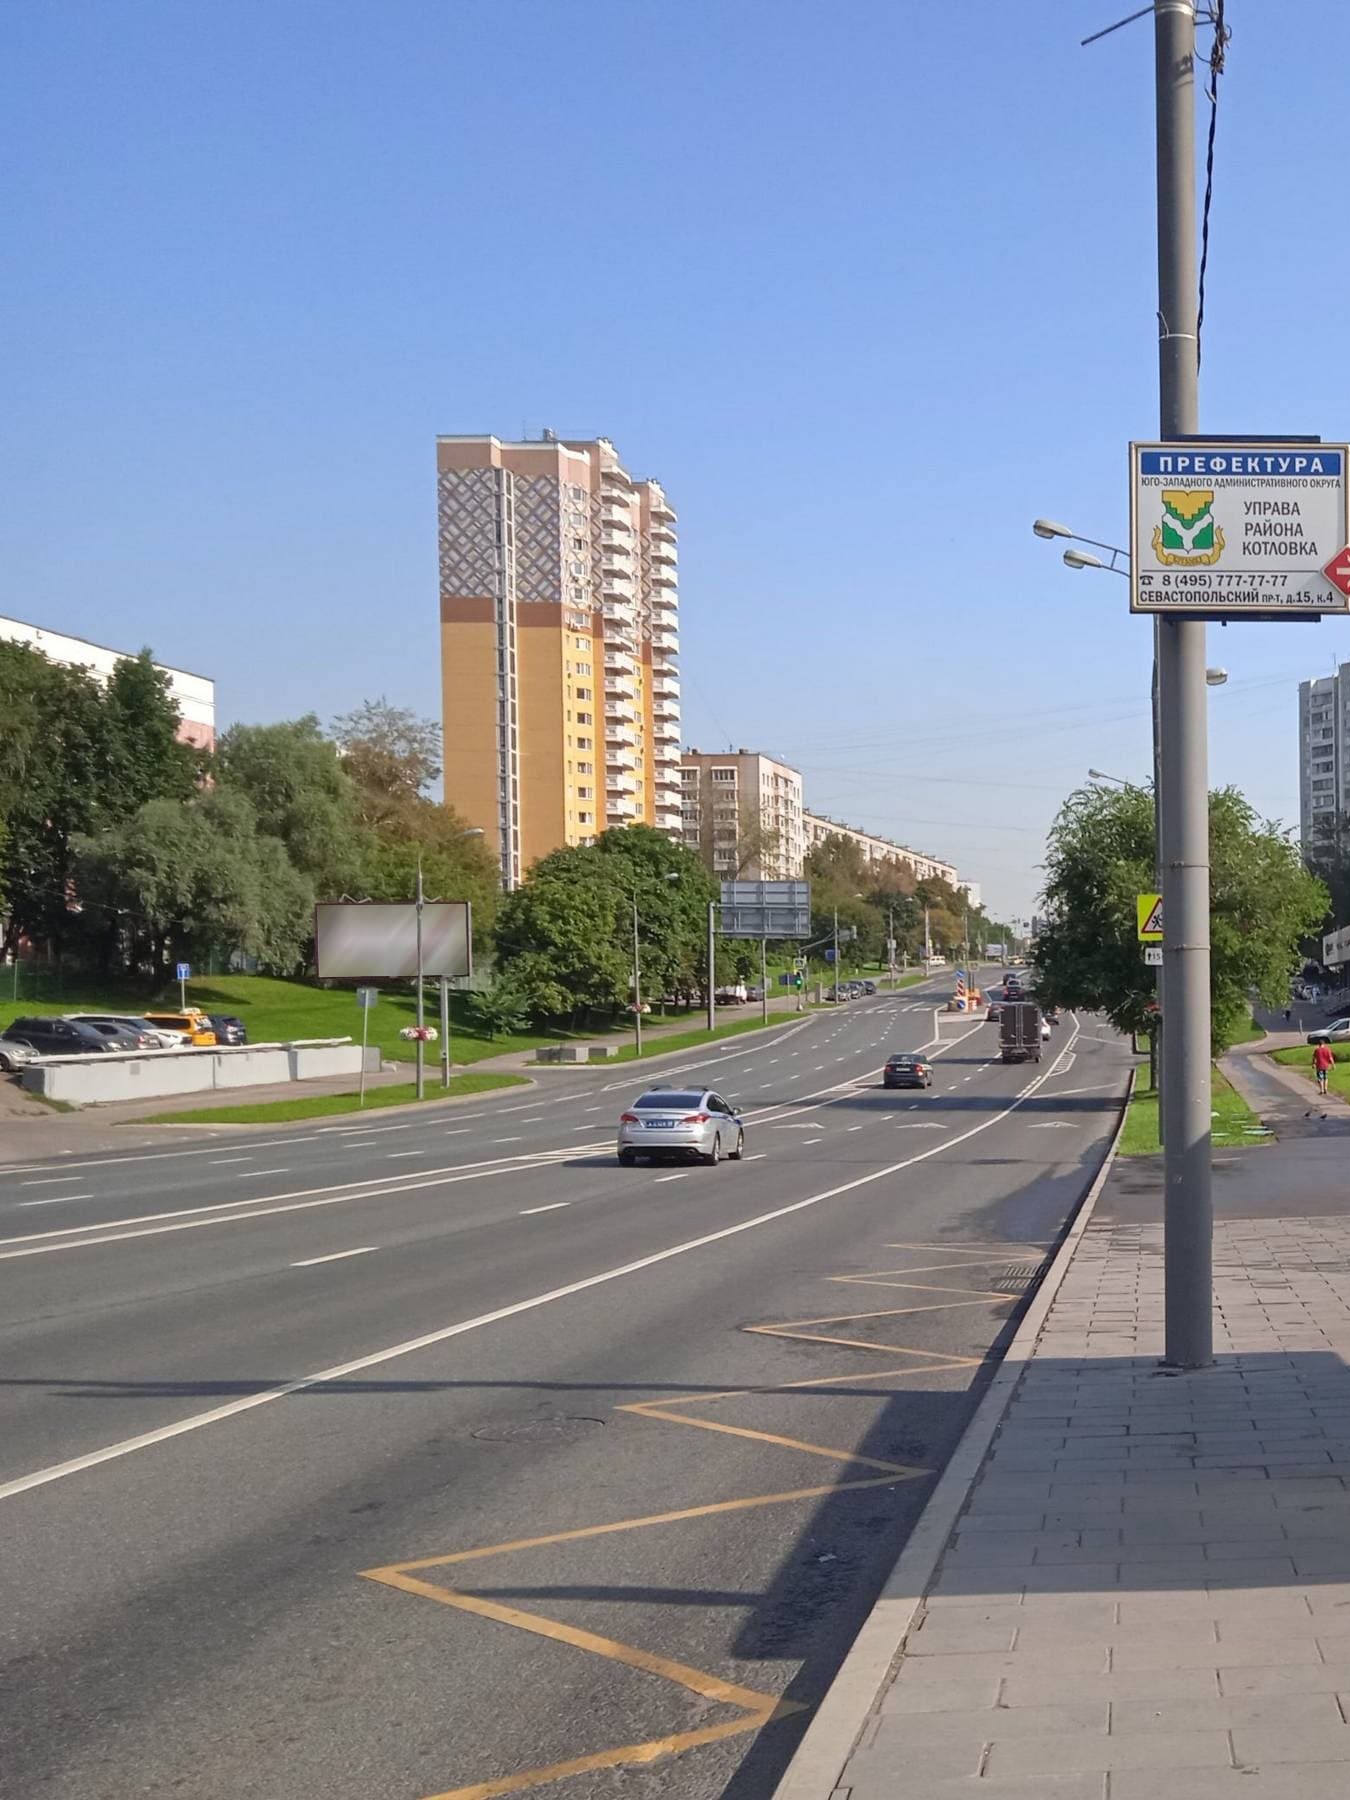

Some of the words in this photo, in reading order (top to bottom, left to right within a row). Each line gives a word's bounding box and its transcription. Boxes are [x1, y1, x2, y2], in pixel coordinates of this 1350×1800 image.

[1159, 456, 1324, 473] ПРЕФЕКТУРА
[1141, 477, 1213, 488] ЮГО-ЗАПАДНОГО
[1214, 478, 1308, 489] АДМИНИСТРАТИВНОГО
[1309, 479, 1341, 489] ОКРУГА
[1243, 501, 1300, 516] УПРАВА
[1244, 519, 1303, 537] РАЙОНА
[1242, 541, 1318, 556] КОТЛОВКА
[1162, 574, 1171, 586] 8
[1175, 574, 1212, 588] (495)
[1217, 574, 1288, 587] 777-77-77
[1140, 588, 1259, 603] СЕВАСТОПОЛЬСКИЙ
